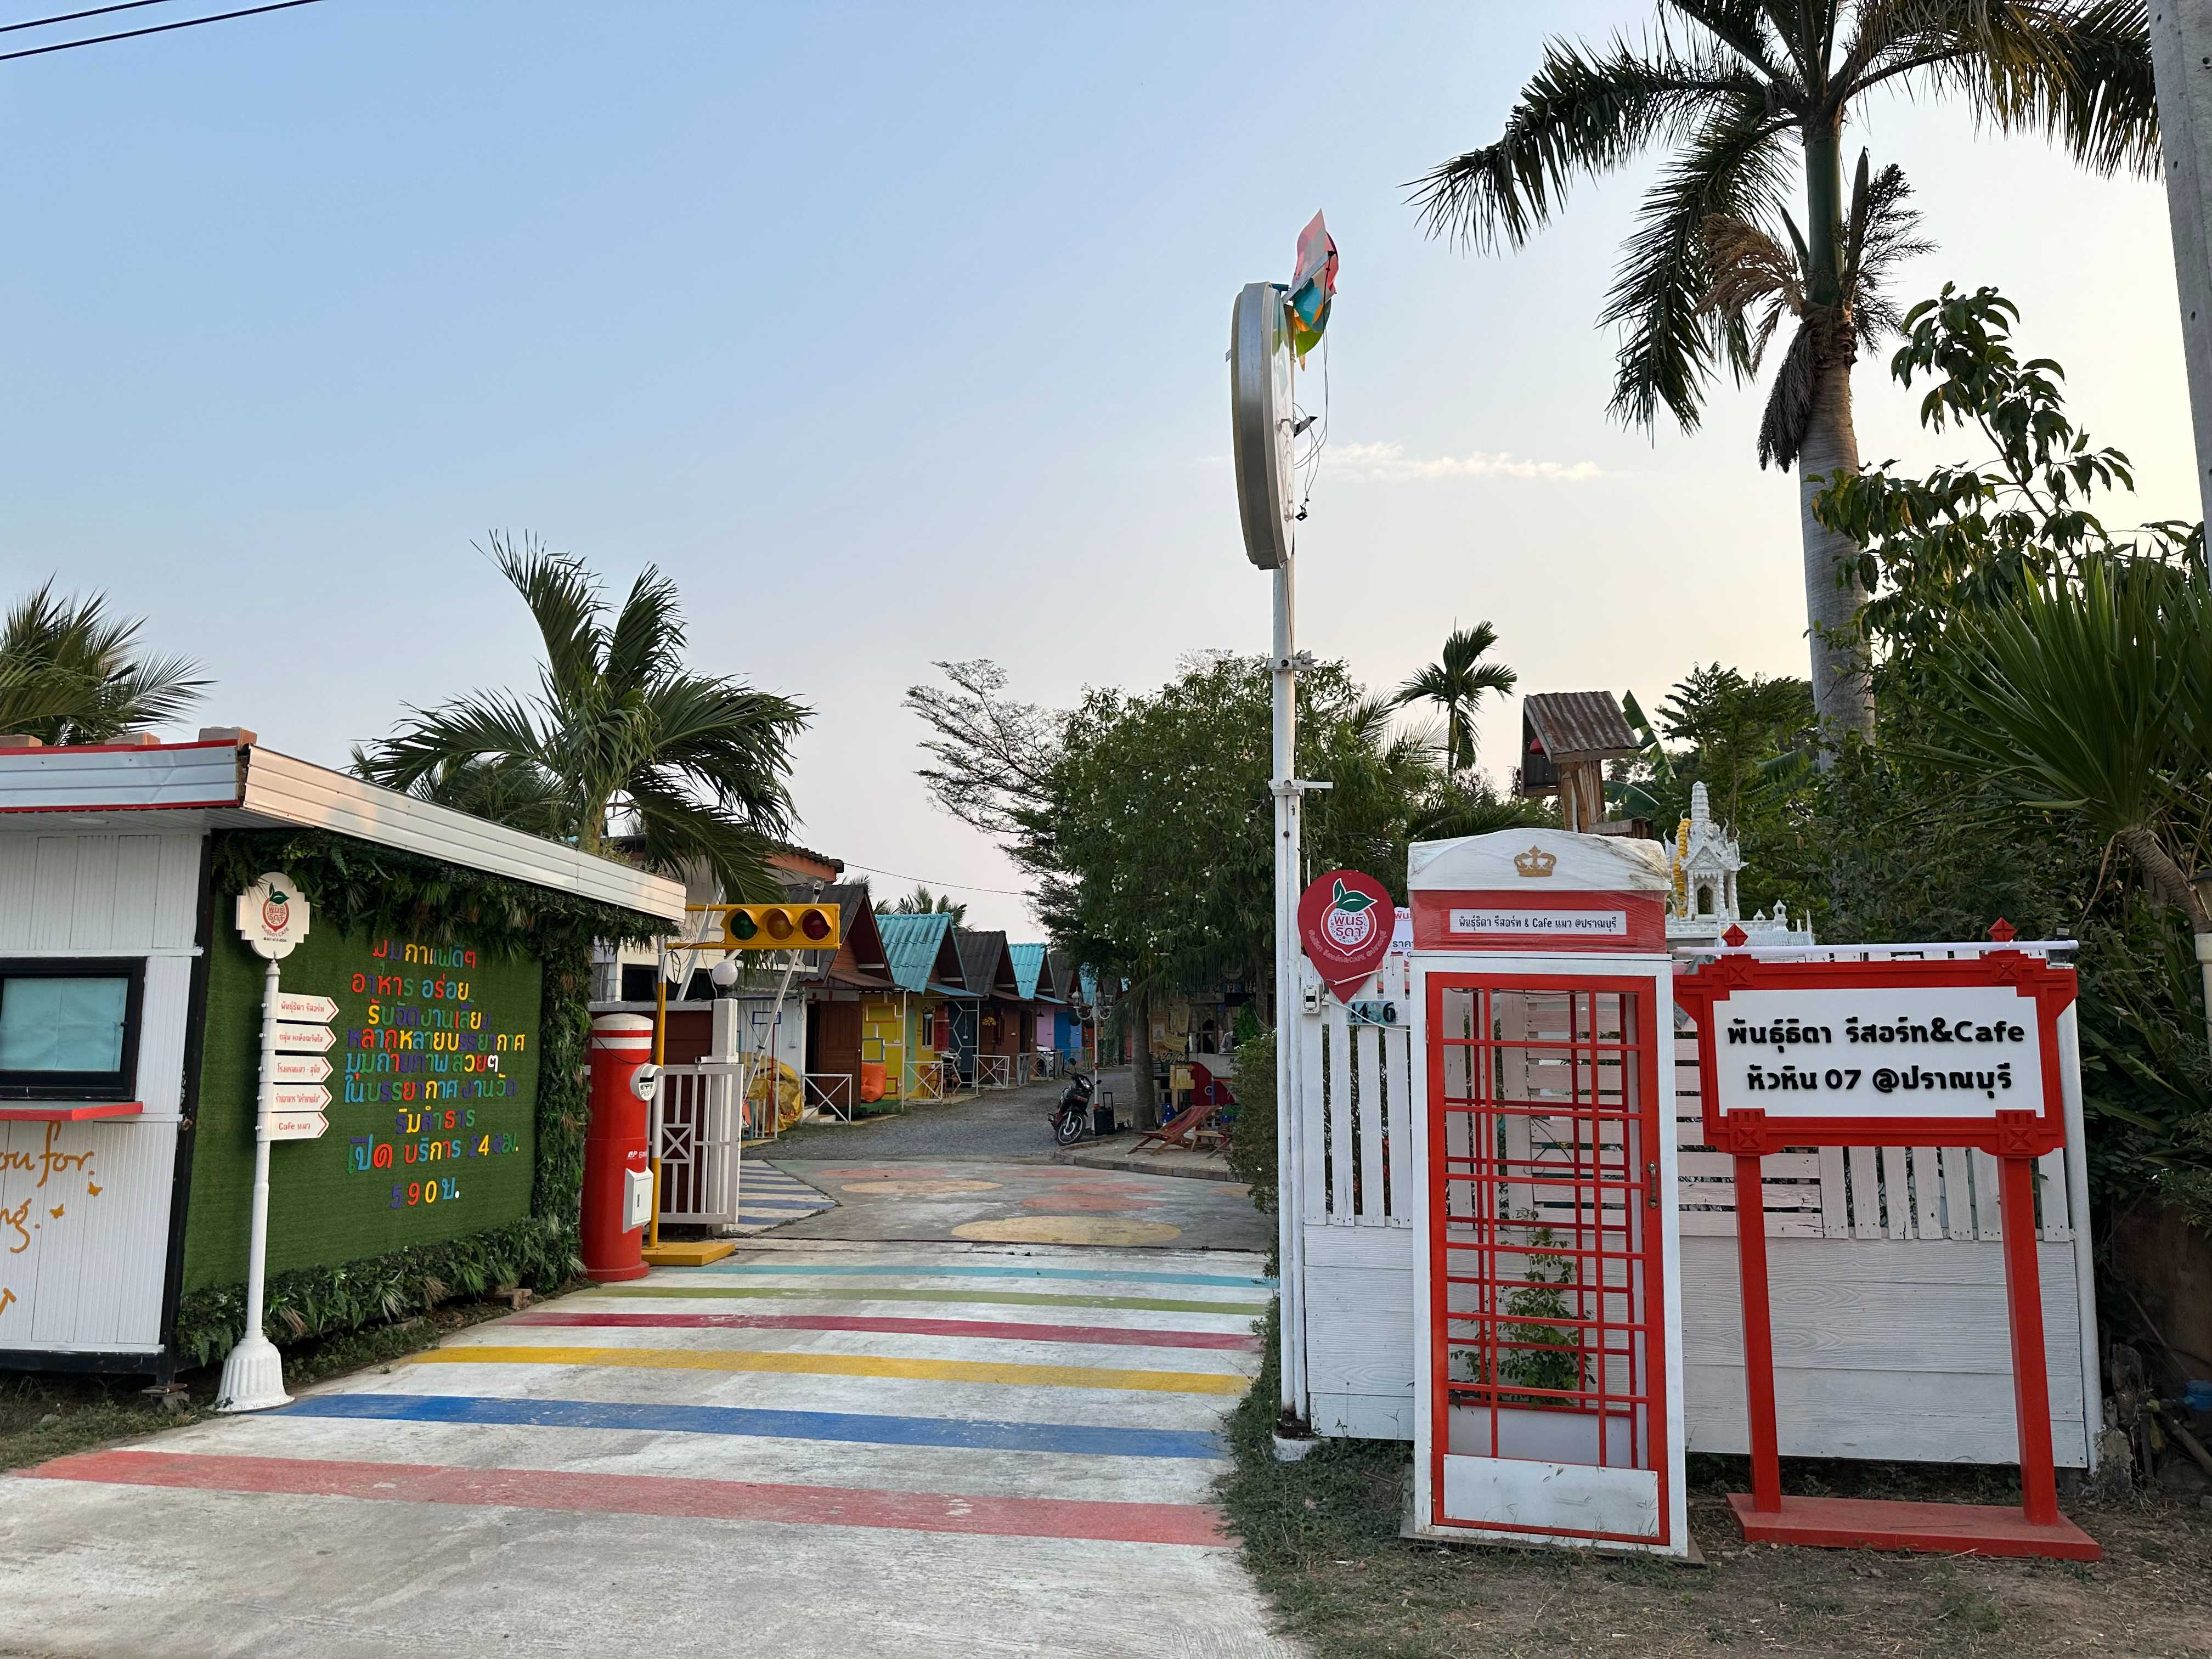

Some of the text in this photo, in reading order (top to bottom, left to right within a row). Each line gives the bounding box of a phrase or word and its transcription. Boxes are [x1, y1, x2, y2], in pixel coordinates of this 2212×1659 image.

[1459, 915, 1617, 932] พันธุ์ธิดา รีสอร์ท & Cafe แมว @ปราณบุรี
[352, 972, 469, 1001] อาหาร อร่อย
[1728, 1016, 2025, 1053] พันธุ์ธิดา รีสอร์ท&Cafe
[1747, 1062, 2012, 1099] หัวหิน 07 @ปราณบุรี
[279, 1122, 295, 1130] Cafe
[396, 1106, 476, 1135] ริมลำธาร
[347, 1133, 393, 1174] เปิด
[404, 1137, 461, 1164] บริการ
[468, 1134, 490, 1158] 24
